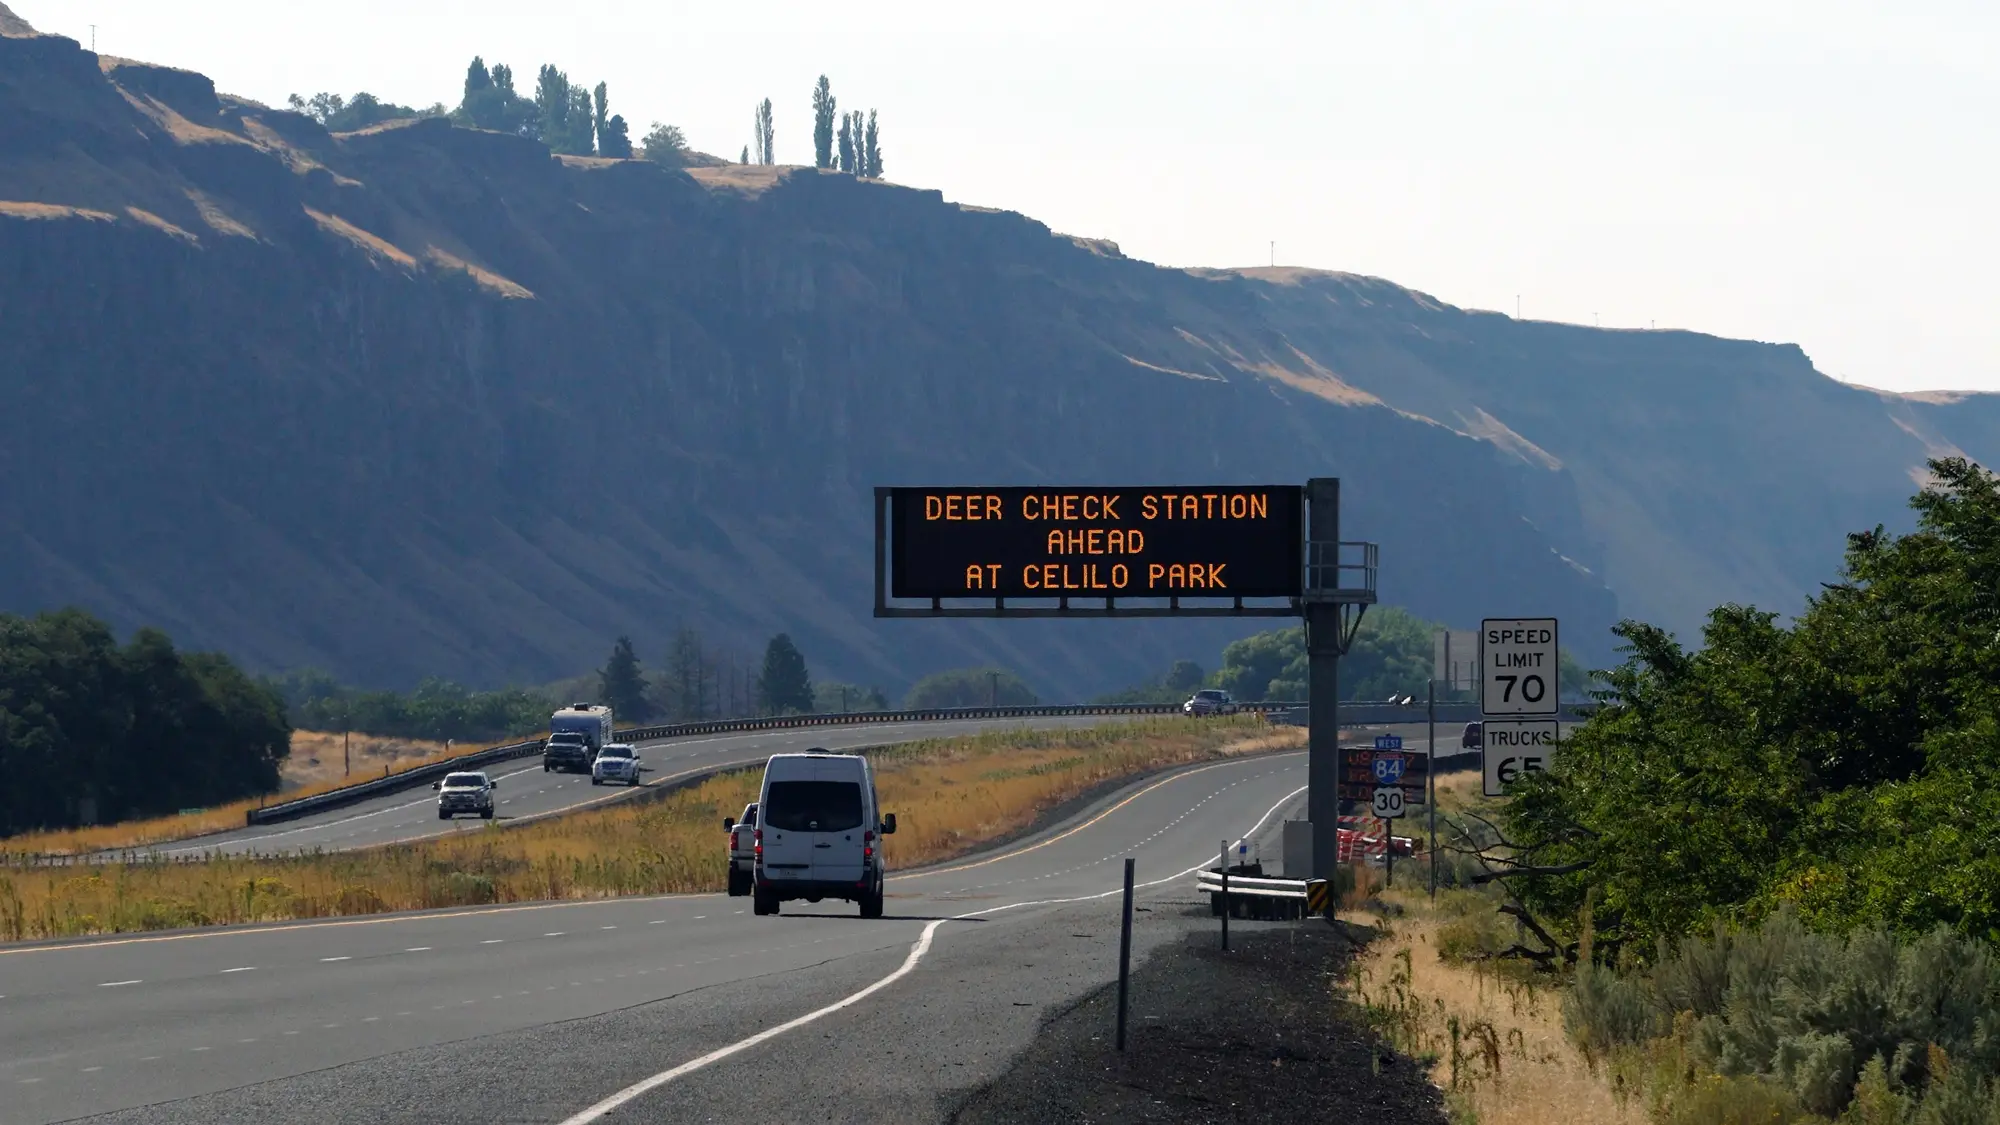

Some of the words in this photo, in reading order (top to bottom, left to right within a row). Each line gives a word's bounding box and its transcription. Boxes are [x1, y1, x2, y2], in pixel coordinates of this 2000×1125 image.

[924, 495, 1003, 520] DEER
[1022, 495, 1121, 520] CHECK
[1141, 494, 1268, 519] STATION
[1047, 529, 1145, 555] AHEAD
[965, 564, 1003, 589] AT
[1022, 564, 1129, 589] CELILO
[1148, 563, 1227, 589] PARK
[1488, 630, 1551, 644] SPEED
[1495, 653, 1544, 667] LIMIT
[1495, 675, 1545, 703] 70
[1377, 739, 1399, 749] WEST
[1489, 731, 1551, 746] TRUCKS
[1376, 759, 1400, 778] 84
[1376, 793, 1401, 811] 30
